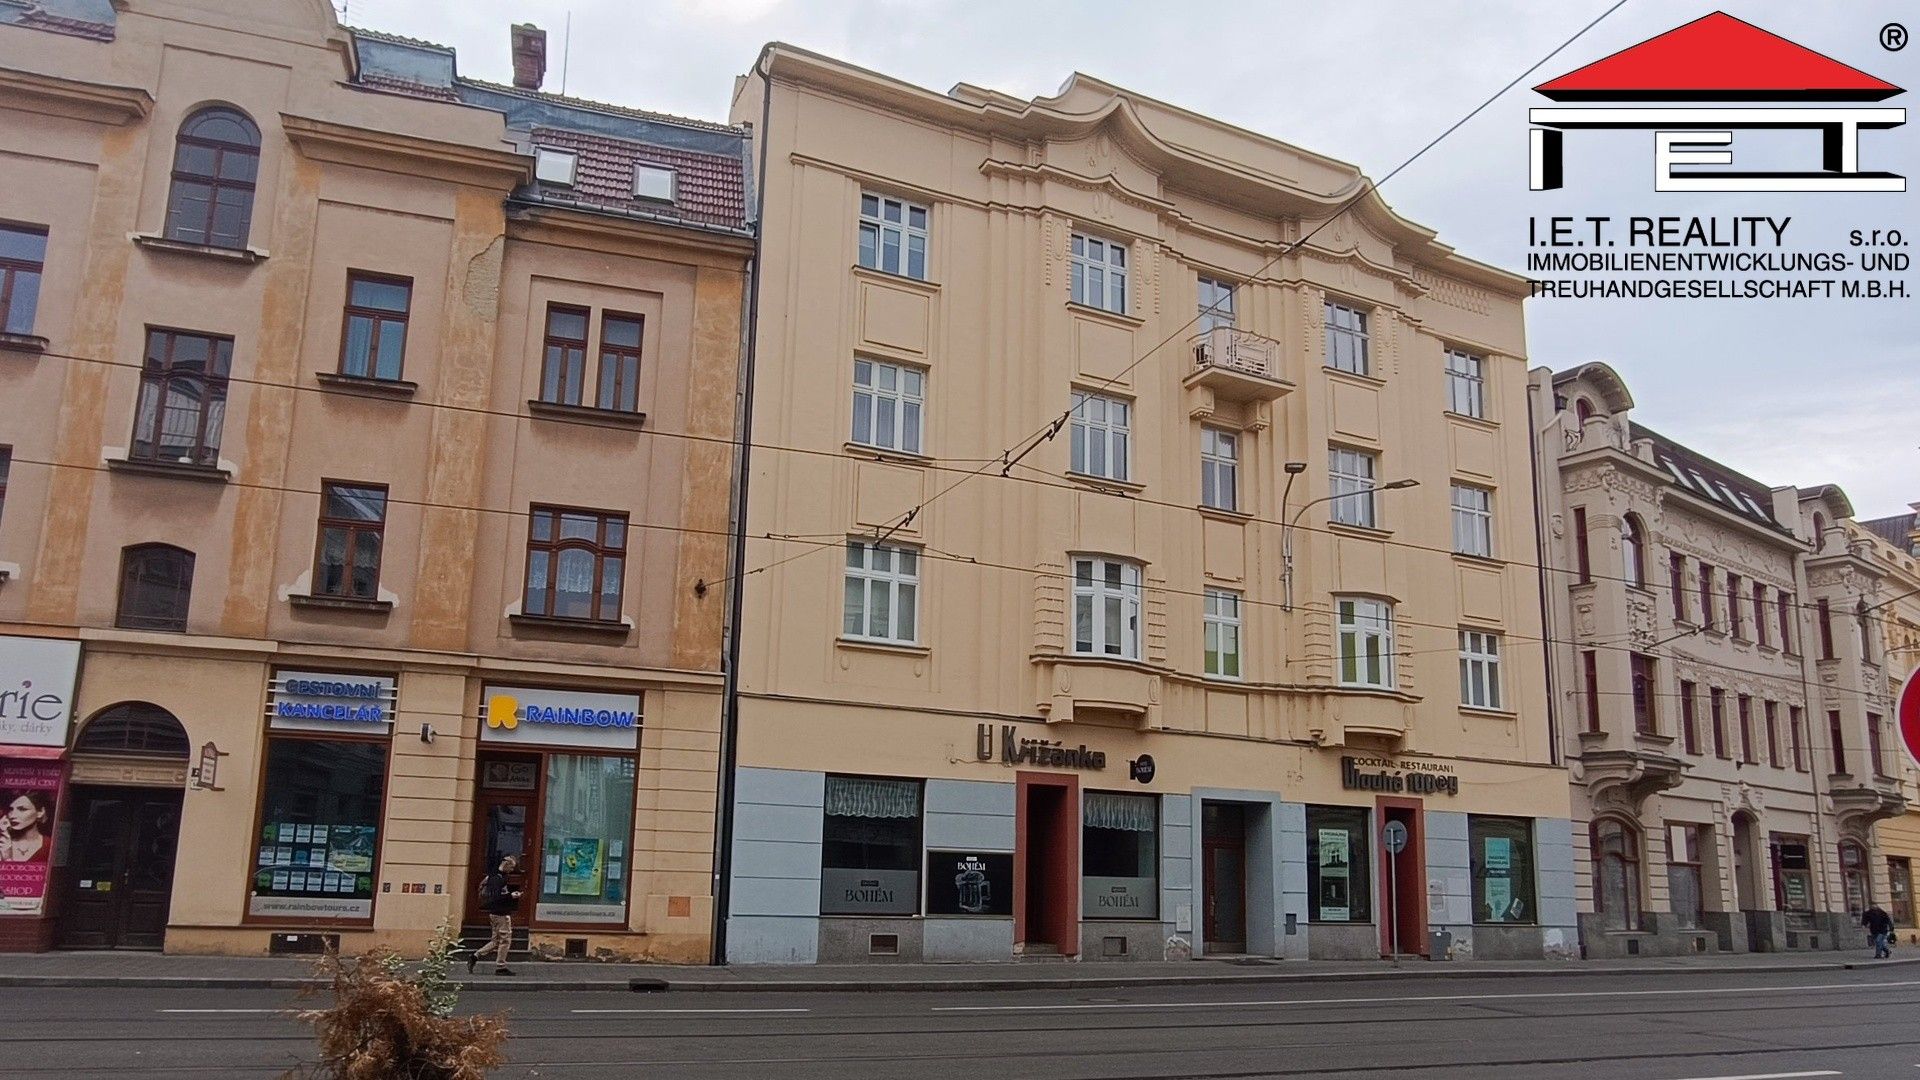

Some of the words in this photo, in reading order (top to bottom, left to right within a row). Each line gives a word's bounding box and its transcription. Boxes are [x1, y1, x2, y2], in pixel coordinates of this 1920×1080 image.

[285, 679, 382, 698] CESTOVNÍ
[278, 701, 383, 722] KANCELÁŘ
[526, 705, 635, 728] RAINBOW
[977, 723, 993, 761] U
[845, 887, 894, 903] BOHÉM
[1099, 894, 1139, 908] BOHÉM
[263, 902, 360, 913] www.rainbowtours.cz
